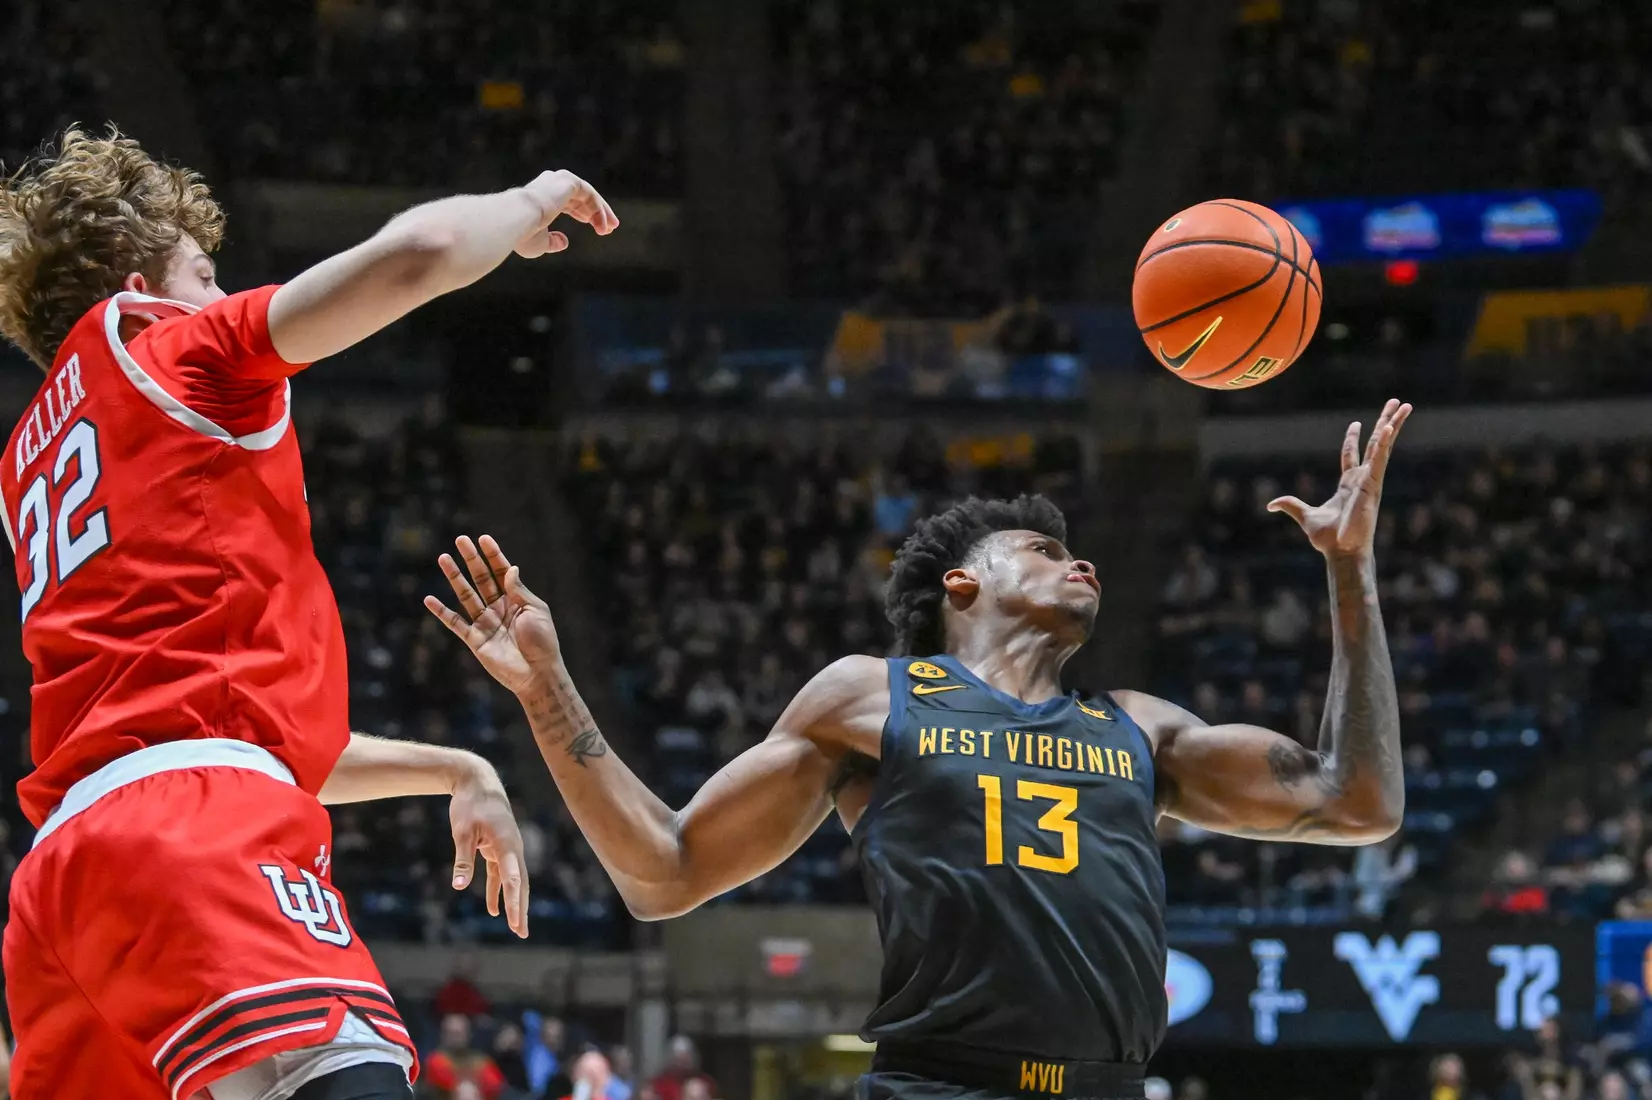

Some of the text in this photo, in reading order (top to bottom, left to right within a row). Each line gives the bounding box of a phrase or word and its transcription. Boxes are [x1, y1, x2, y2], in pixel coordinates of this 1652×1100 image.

[18, 416, 111, 624] 32
[918, 728, 1134, 781] WEST VIRGINIA
[977, 774, 1079, 875] 13
[1487, 943, 1561, 1030] 72
[1020, 1060, 1065, 1094] WVU
